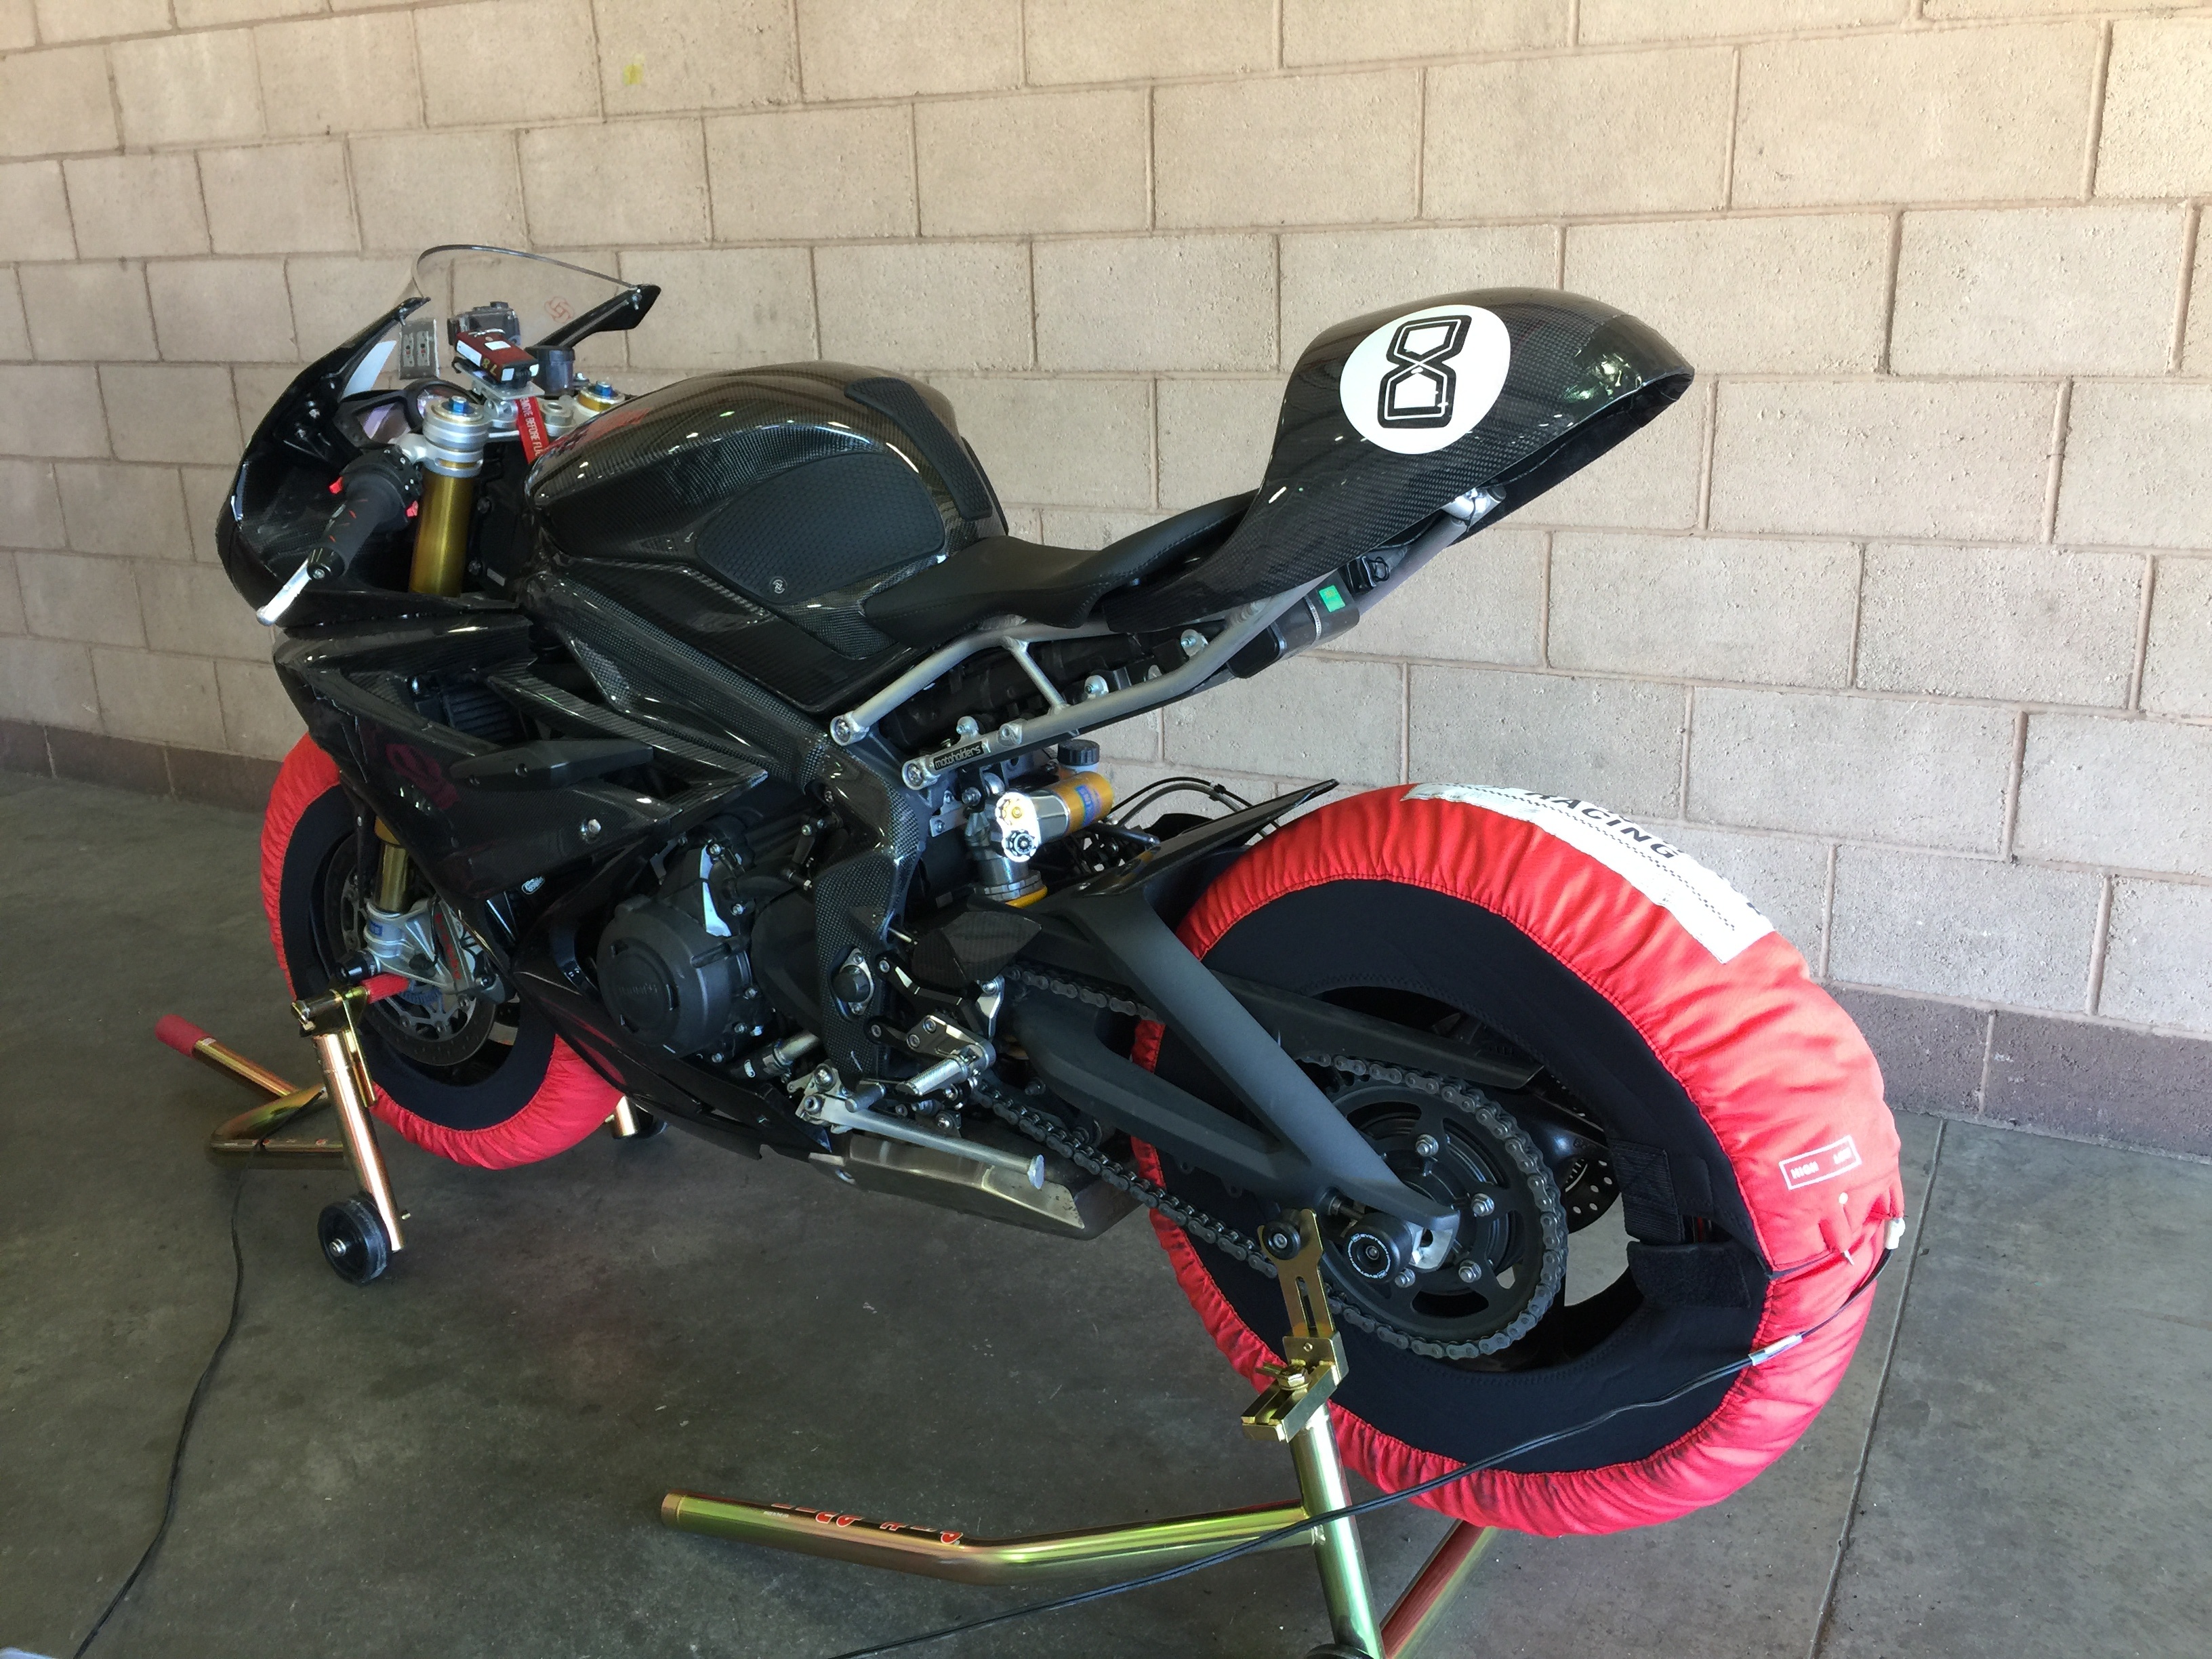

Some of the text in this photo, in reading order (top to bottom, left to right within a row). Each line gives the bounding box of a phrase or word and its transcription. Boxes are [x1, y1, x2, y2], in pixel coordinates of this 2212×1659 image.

[1378, 315, 1472, 429] 8
[520, 397, 533, 417] EMOVE
[525, 417, 541, 441] BEFORE
[935, 745, 981, 769] motoholders
